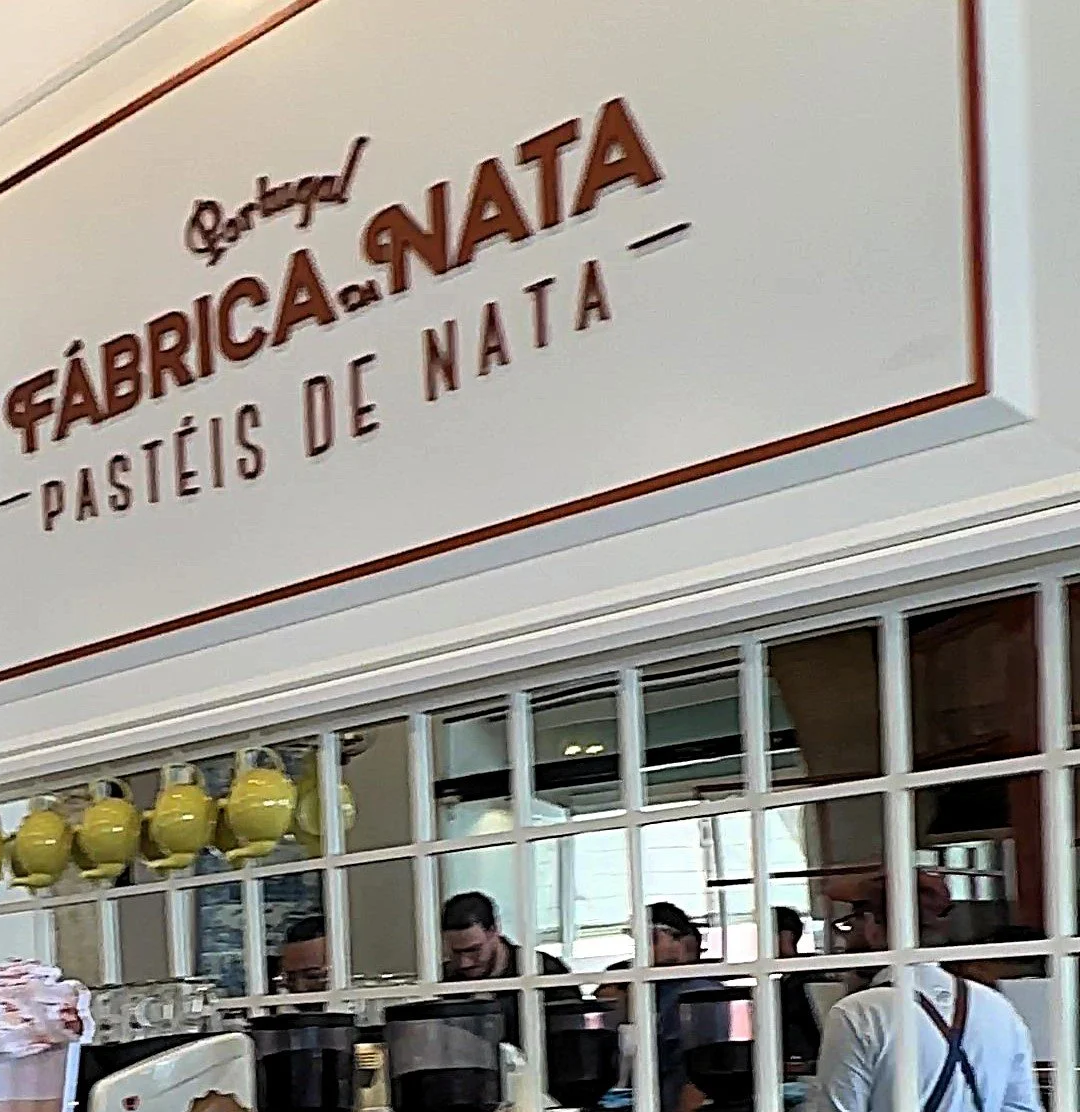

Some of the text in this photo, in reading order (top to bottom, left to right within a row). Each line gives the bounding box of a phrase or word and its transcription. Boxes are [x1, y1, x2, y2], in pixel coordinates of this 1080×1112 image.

[2, 247, 337, 455] FÁBRICA
[360, 96, 666, 295] NATA
[184, 135, 371, 267] Portugal
[43, 258, 613, 531] PASTÉIS DE NATA
